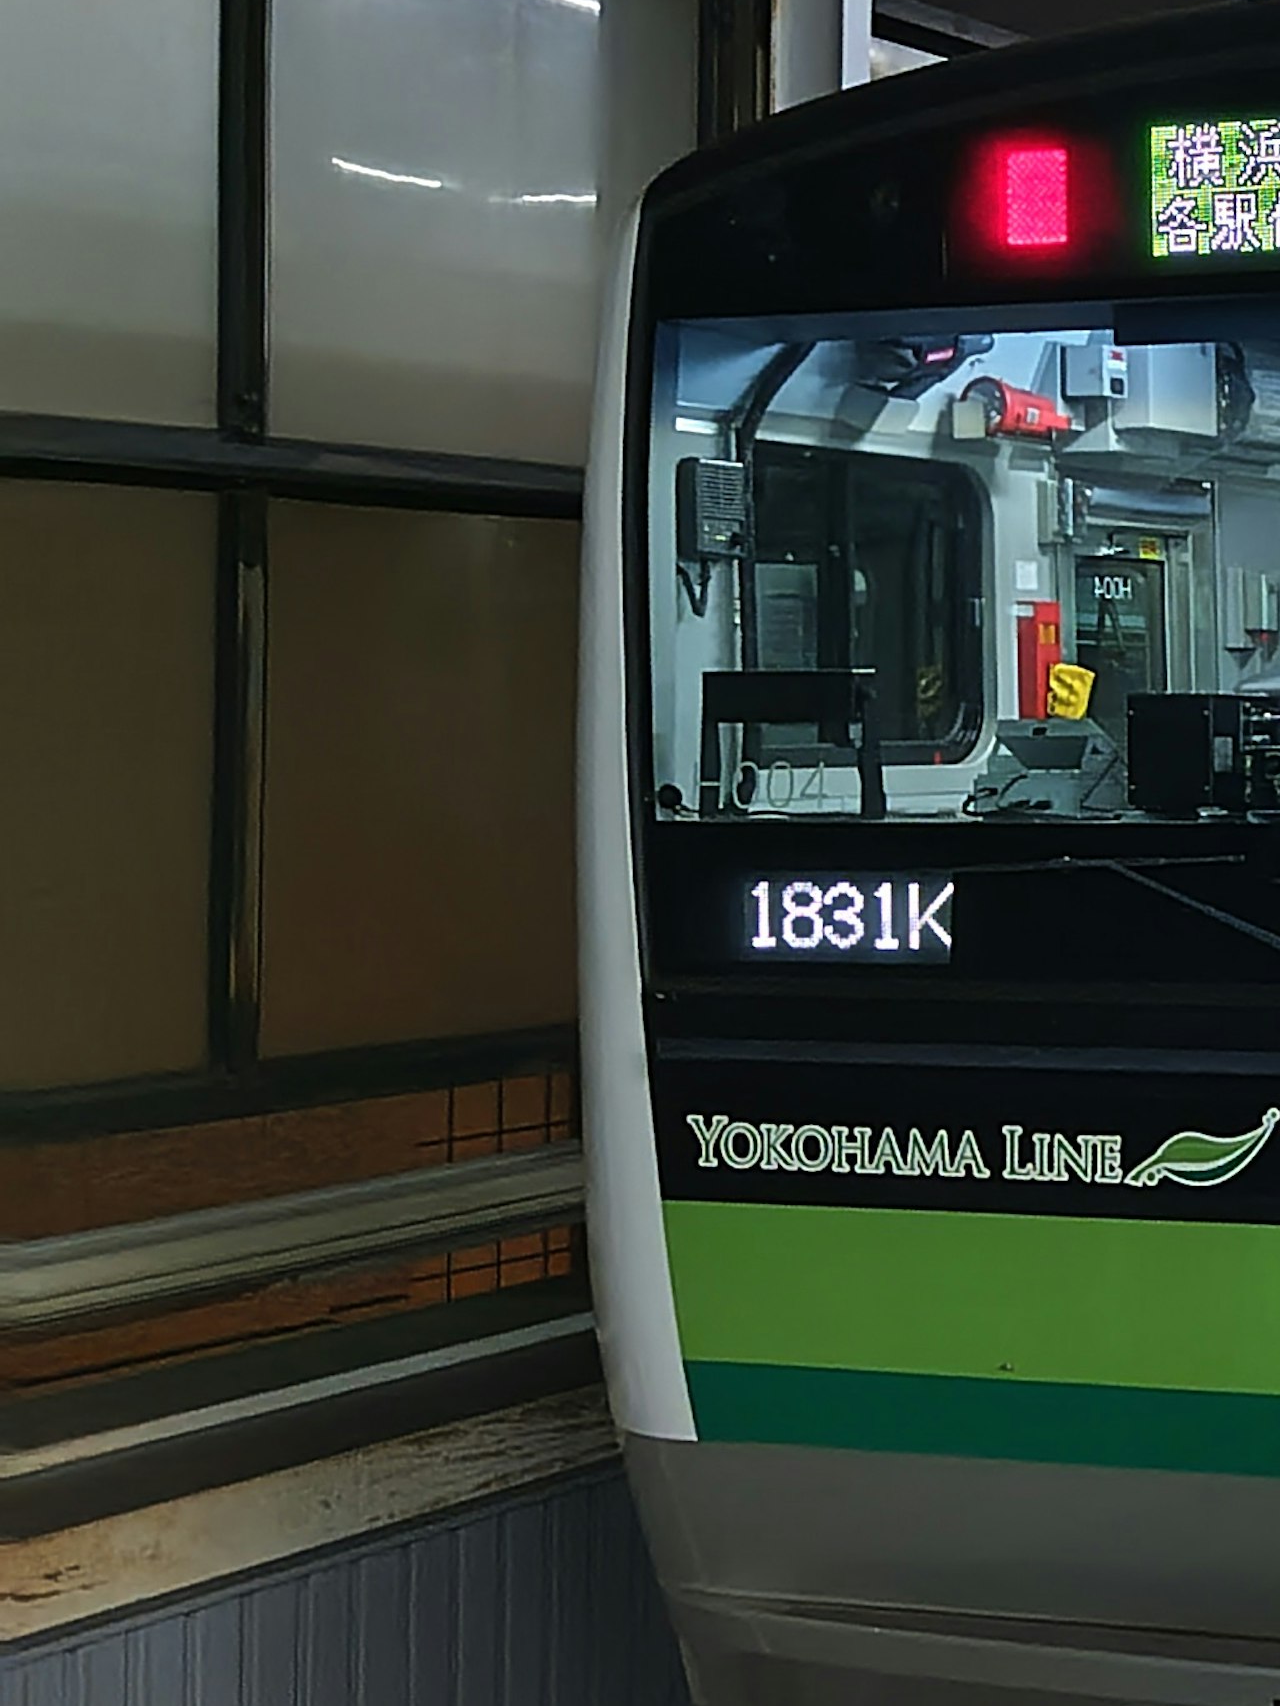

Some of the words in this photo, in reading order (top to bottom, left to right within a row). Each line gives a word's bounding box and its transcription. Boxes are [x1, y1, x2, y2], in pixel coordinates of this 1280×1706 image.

[751, 881, 955, 950] 1831K
[687, 1114, 990, 1179] YOKOHAMA
[1001, 1124, 1123, 1184] LINE
